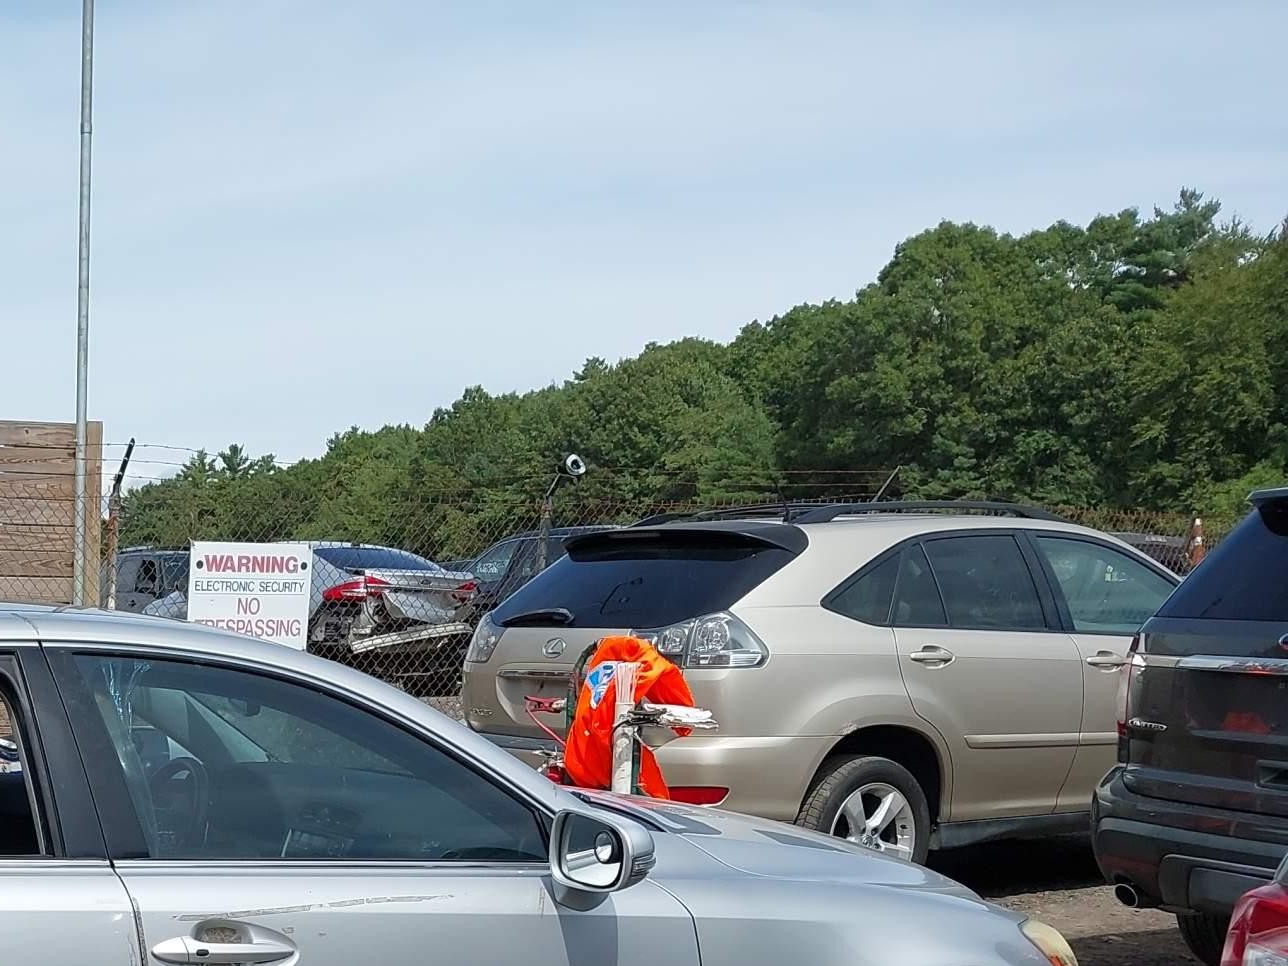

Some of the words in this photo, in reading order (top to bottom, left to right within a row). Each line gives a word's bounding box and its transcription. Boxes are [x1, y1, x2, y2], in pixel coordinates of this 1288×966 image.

[204, 554, 299, 574] WARNING
[194, 580, 255, 593] ELECTRONIC
[258, 581, 305, 593] SECURITY
[237, 597, 261, 615] NO
[195, 619, 301, 637] ESPASSING
